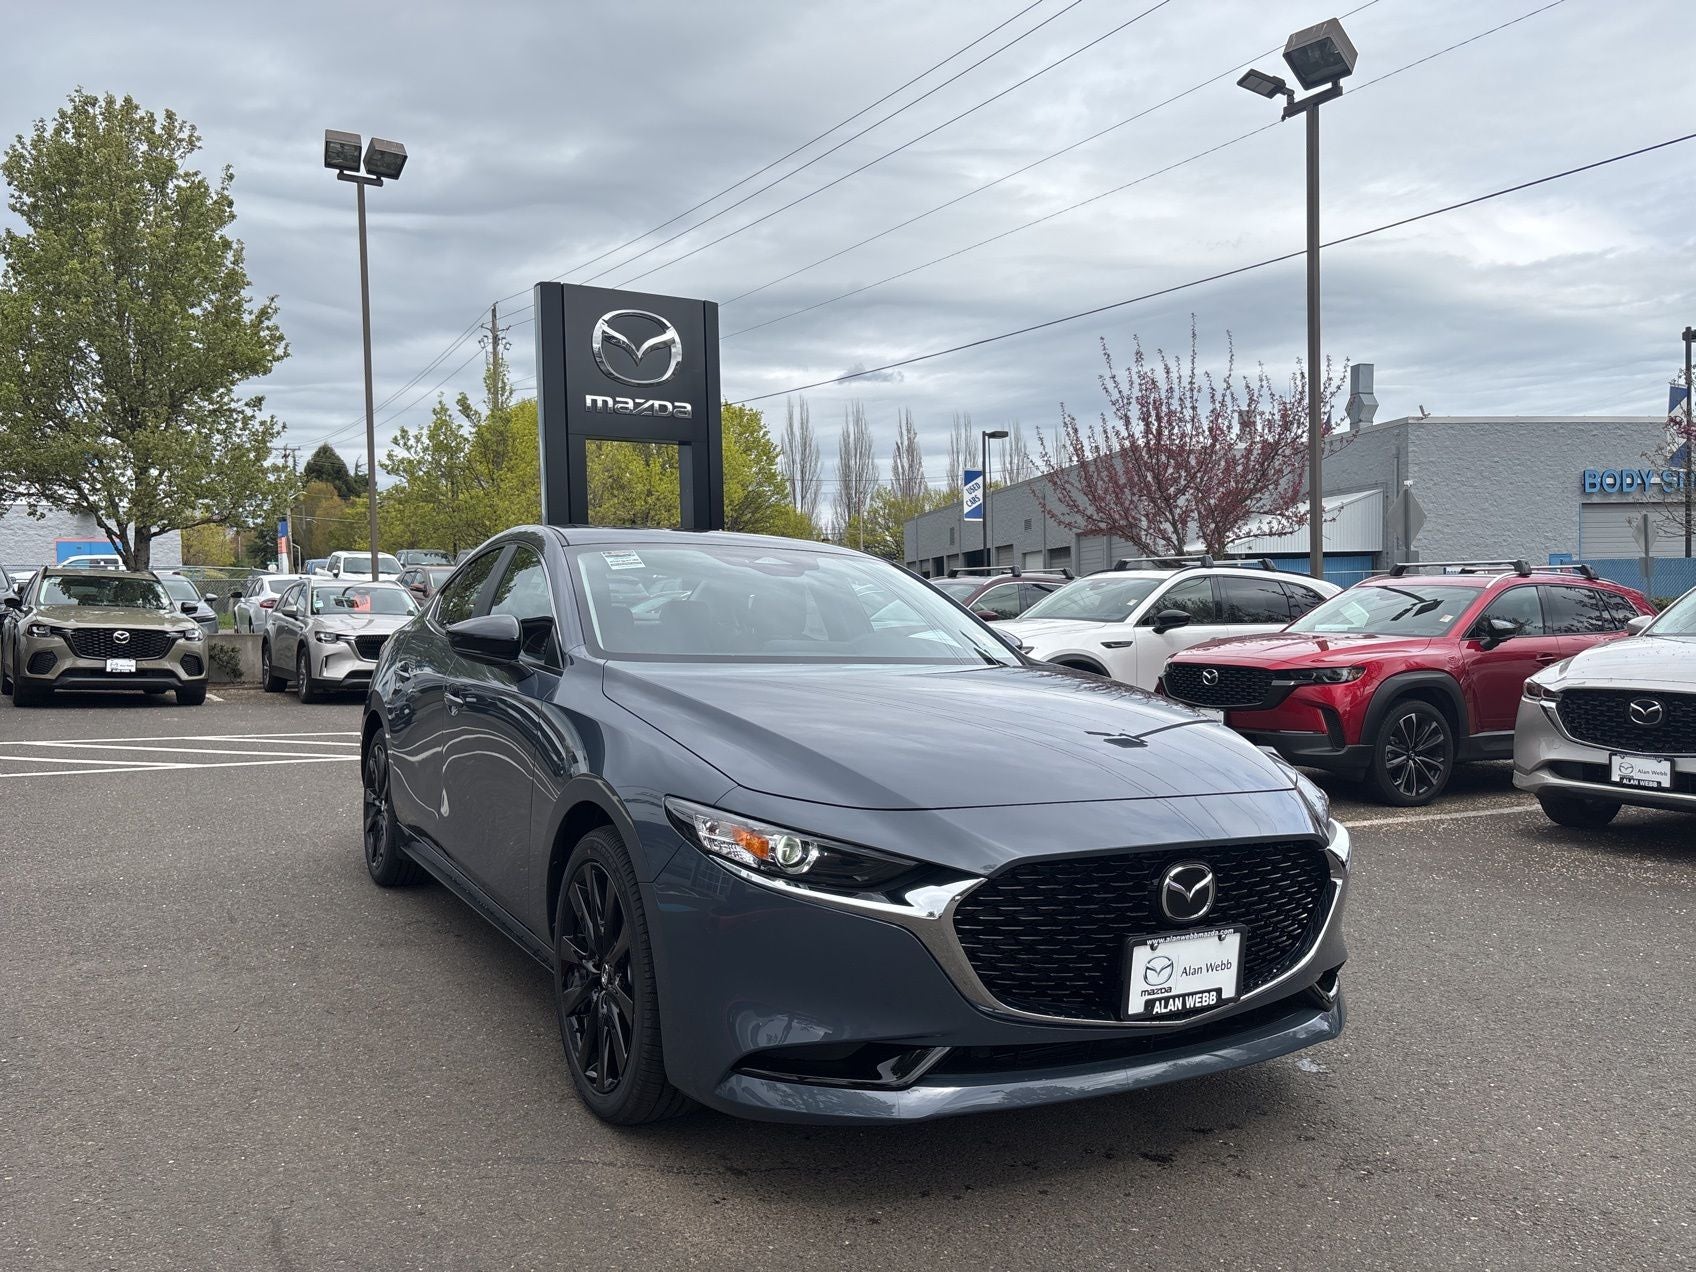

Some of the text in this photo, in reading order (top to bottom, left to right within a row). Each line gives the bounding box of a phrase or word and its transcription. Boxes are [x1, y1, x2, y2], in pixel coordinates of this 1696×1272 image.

[585, 395, 692, 418] mazda
[966, 482, 981, 495] USED
[1583, 469, 1653, 493] BODY
[965, 495, 981, 508] CARS
[1622, 778, 1658, 788] ALAN WEBB
[1146, 928, 1234, 945] www.alanwebbmazda.com
[1180, 959, 1232, 977] Alan Webb
[1140, 986, 1173, 998] mazda
[1153, 991, 1217, 1015] ALAN WEBB
